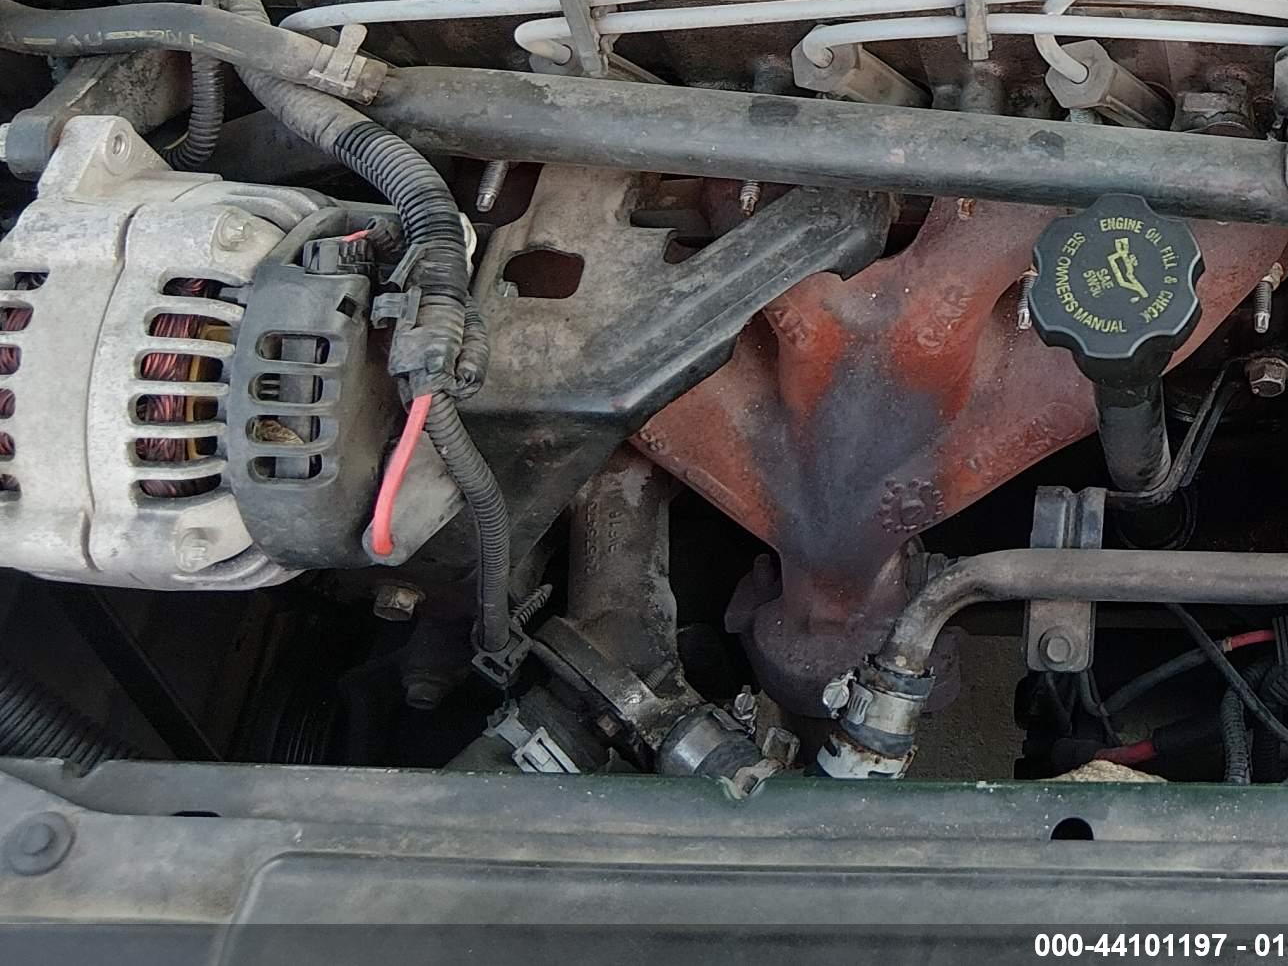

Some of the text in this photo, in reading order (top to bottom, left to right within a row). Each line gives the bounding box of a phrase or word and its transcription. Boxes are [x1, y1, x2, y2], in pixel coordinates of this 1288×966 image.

[1062, 232, 1086, 256] SEE
[1095, 268, 1114, 290] SAE
[1100, 217, 1178, 323] ENGINE OIL FILL & CHECK
[1073, 308, 1127, 333] MANUAL
